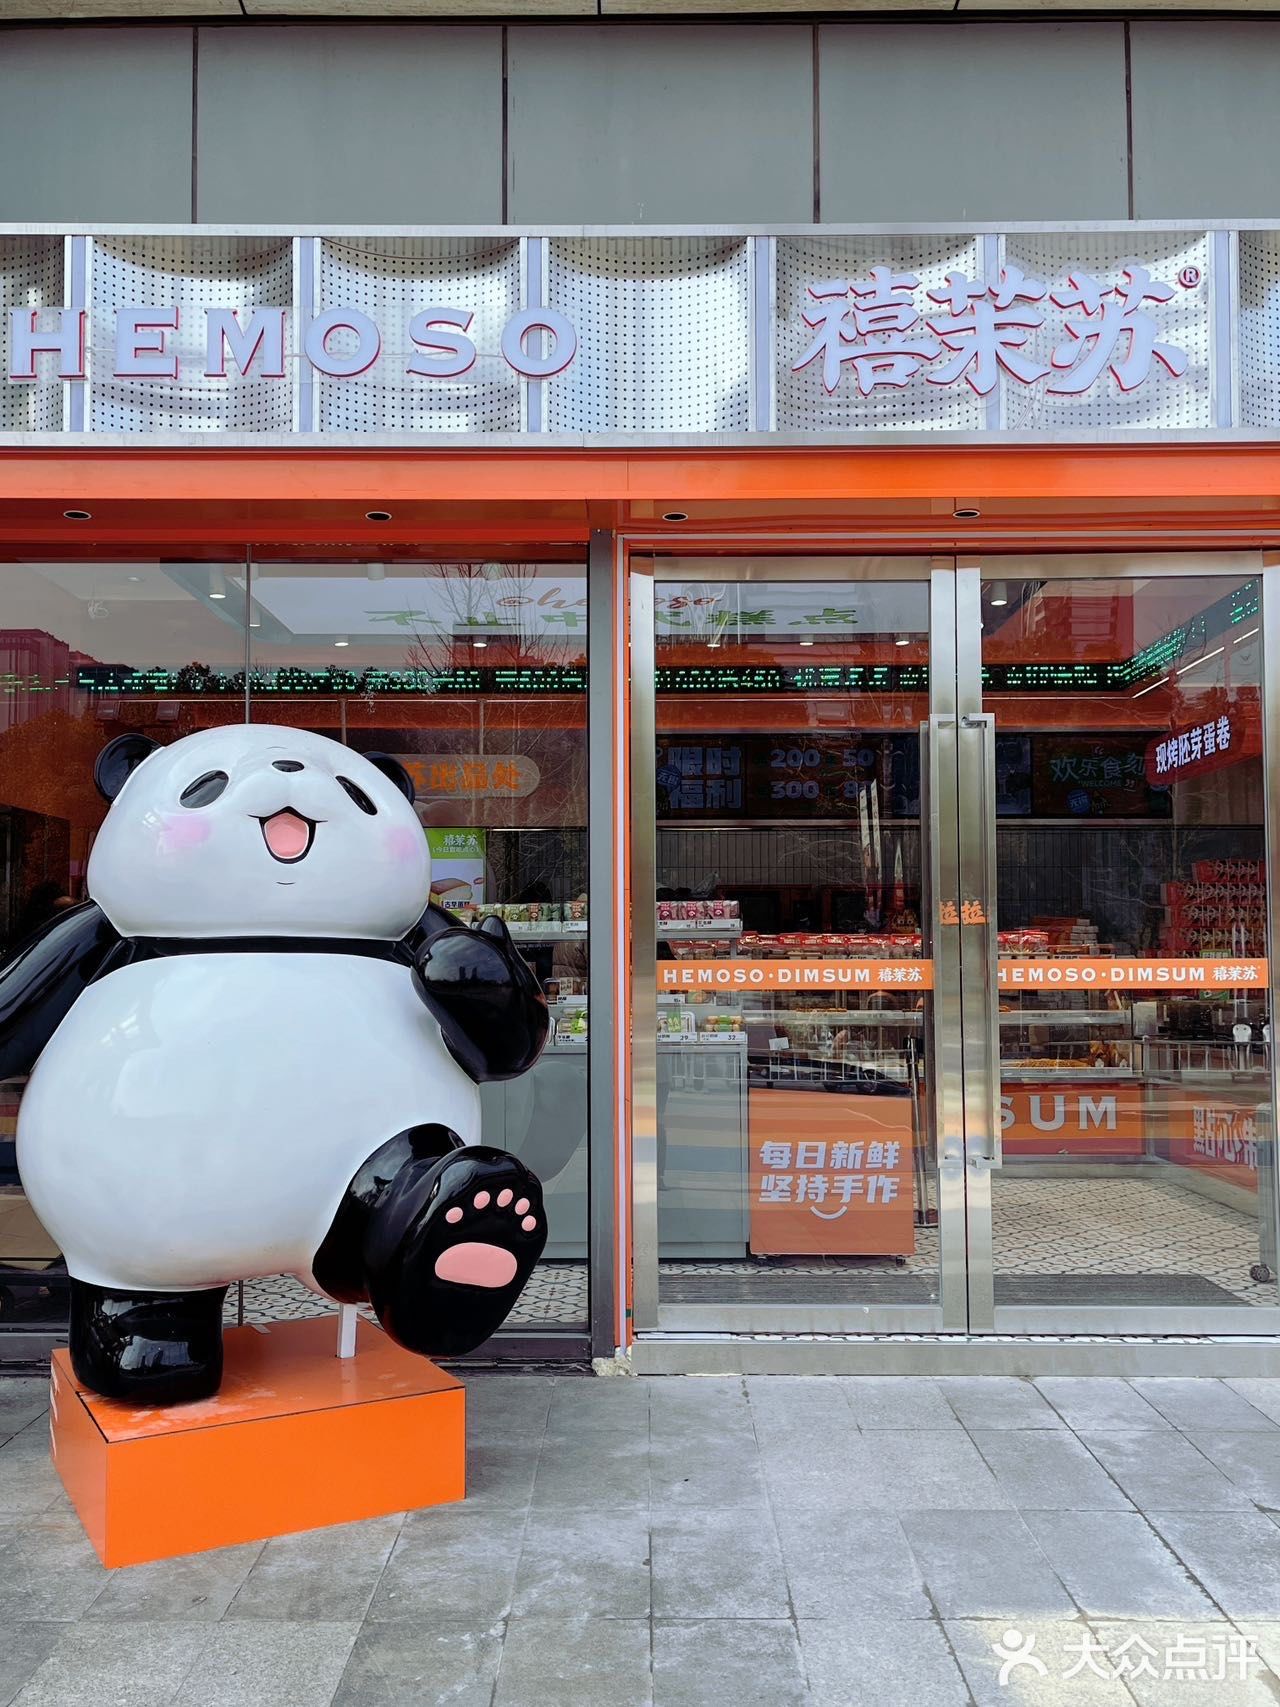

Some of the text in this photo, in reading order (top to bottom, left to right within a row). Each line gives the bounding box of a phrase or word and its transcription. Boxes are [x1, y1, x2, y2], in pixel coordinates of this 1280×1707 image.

[9, 306, 578, 379] HEMOSO
[792, 265, 1188, 396] 禧茉苏
[770, 749, 821, 768] 200
[1156, 715, 1231, 774] 现烤胚芽蛋卷
[668, 746, 742, 777] 限时
[770, 780, 820, 799] 300
[961, 900, 986, 925] 拉
[759, 1140, 900, 1169] 每日新鲜
[758, 1174, 900, 1204] 坚持手作
